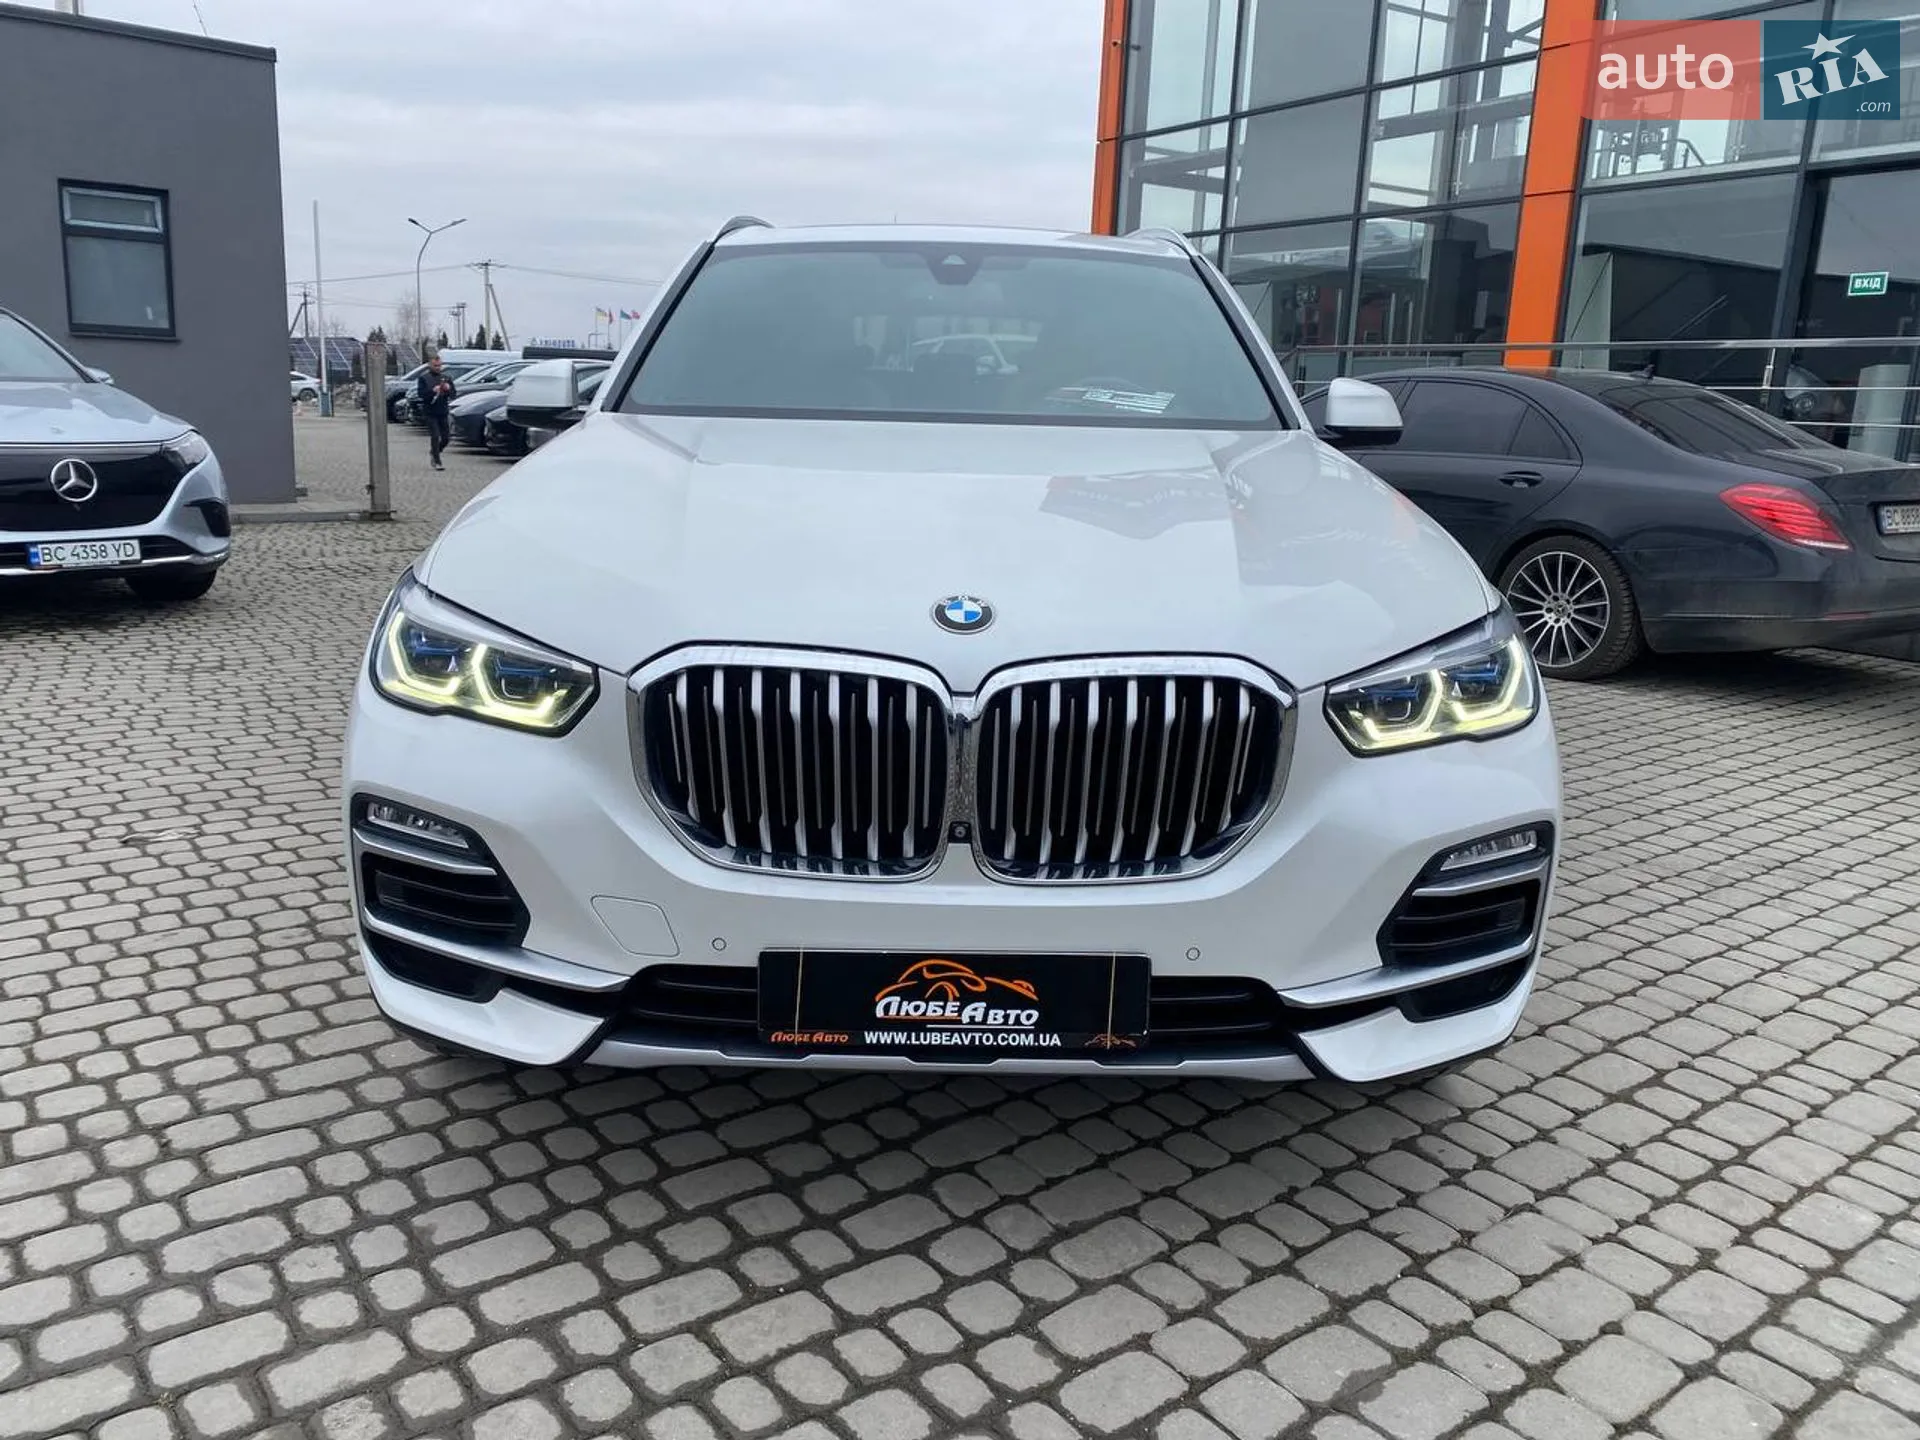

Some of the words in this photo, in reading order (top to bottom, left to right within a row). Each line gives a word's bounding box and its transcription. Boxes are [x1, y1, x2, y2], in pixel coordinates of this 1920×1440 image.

[1854, 277, 1881, 289] ВХІД
[40, 546, 65, 562] BC
[70, 543, 108, 560] 4358
[111, 542, 135, 558] YD
[864, 1031, 1061, 1047] WWW.LUBEAVTO.COM.UA
